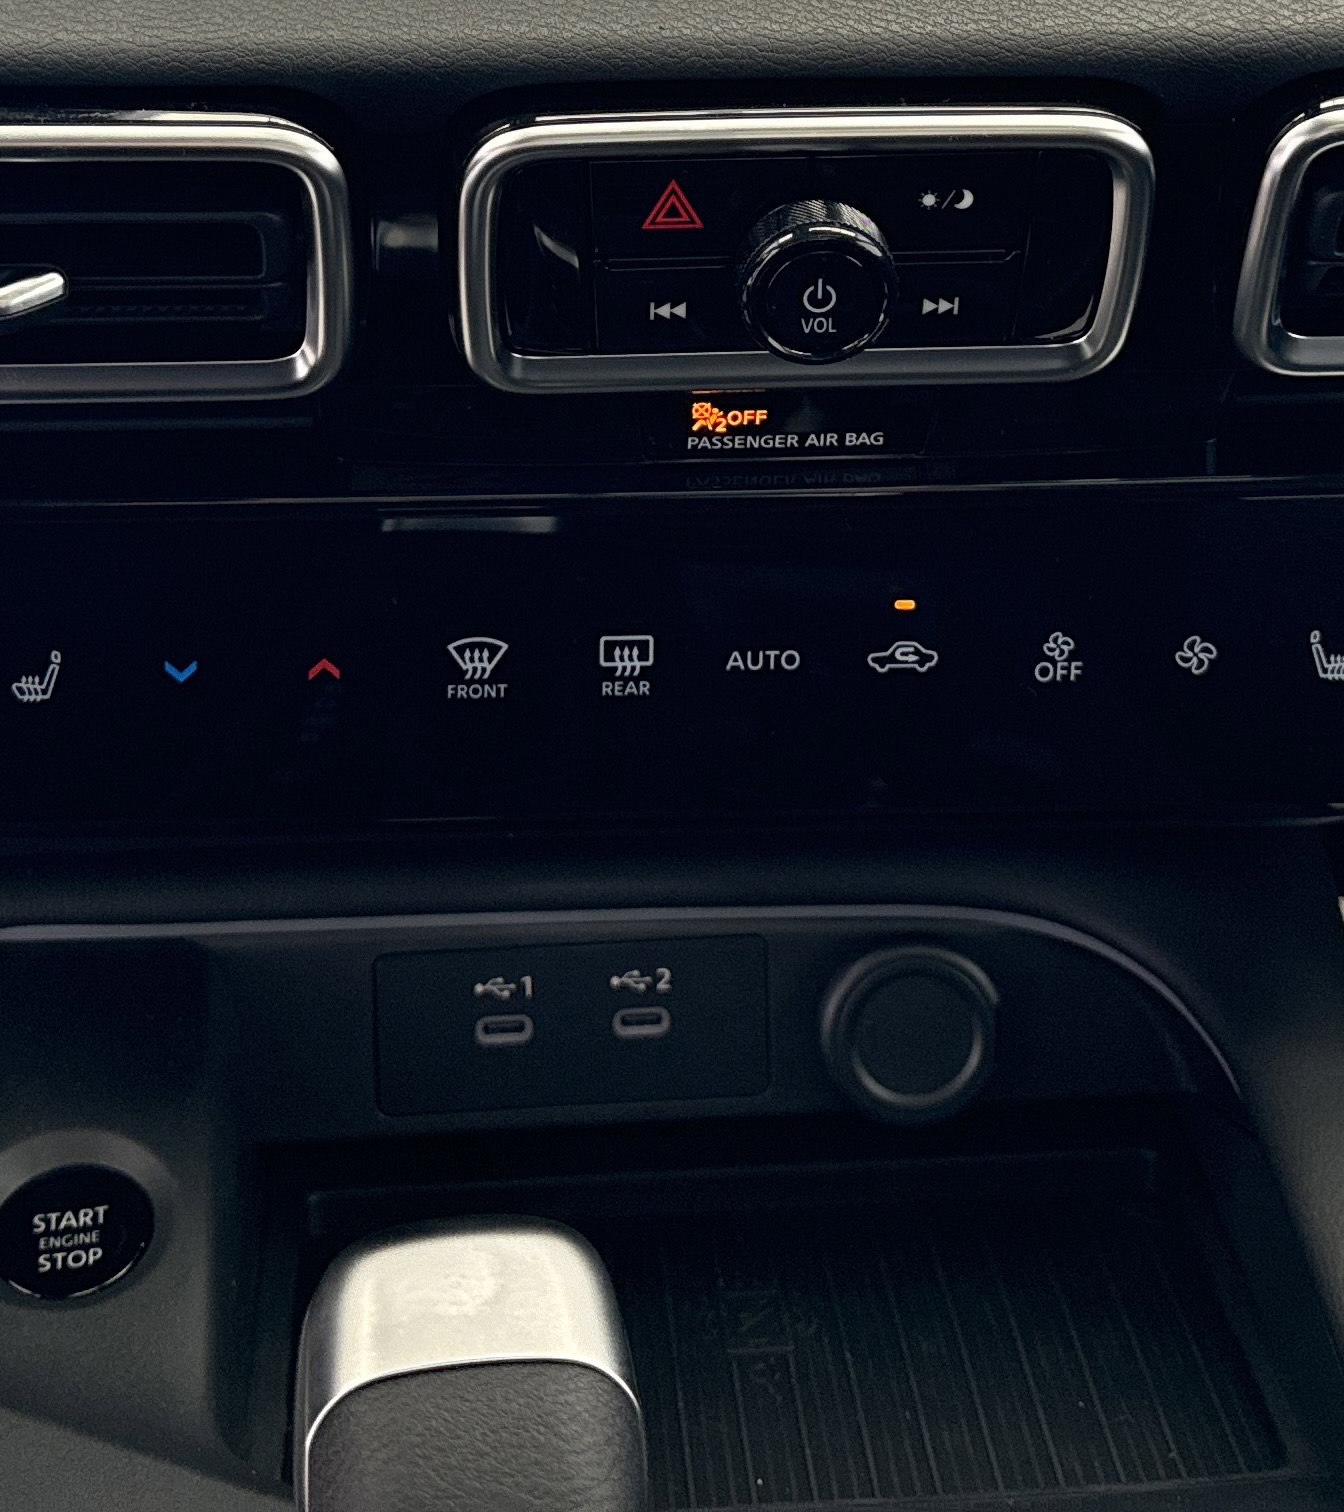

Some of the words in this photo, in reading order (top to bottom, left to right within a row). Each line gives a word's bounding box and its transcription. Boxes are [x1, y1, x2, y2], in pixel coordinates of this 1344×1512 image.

[800, 317, 838, 335] VOL
[727, 409, 769, 426] OFF
[687, 434, 799, 450] PASSENGER
[805, 432, 839, 448] AIR
[845, 431, 884, 447] BAG
[726, 650, 802, 671] AUTO
[1034, 661, 1084, 683] OFF
[447, 683, 508, 700] FRONT
[601, 680, 652, 697] REAR
[520, 975, 534, 998] 1
[656, 967, 672, 992] 2
[32, 1204, 109, 1235] START
[38, 1230, 101, 1251] ENGINE
[38, 1247, 103, 1273] STOP
